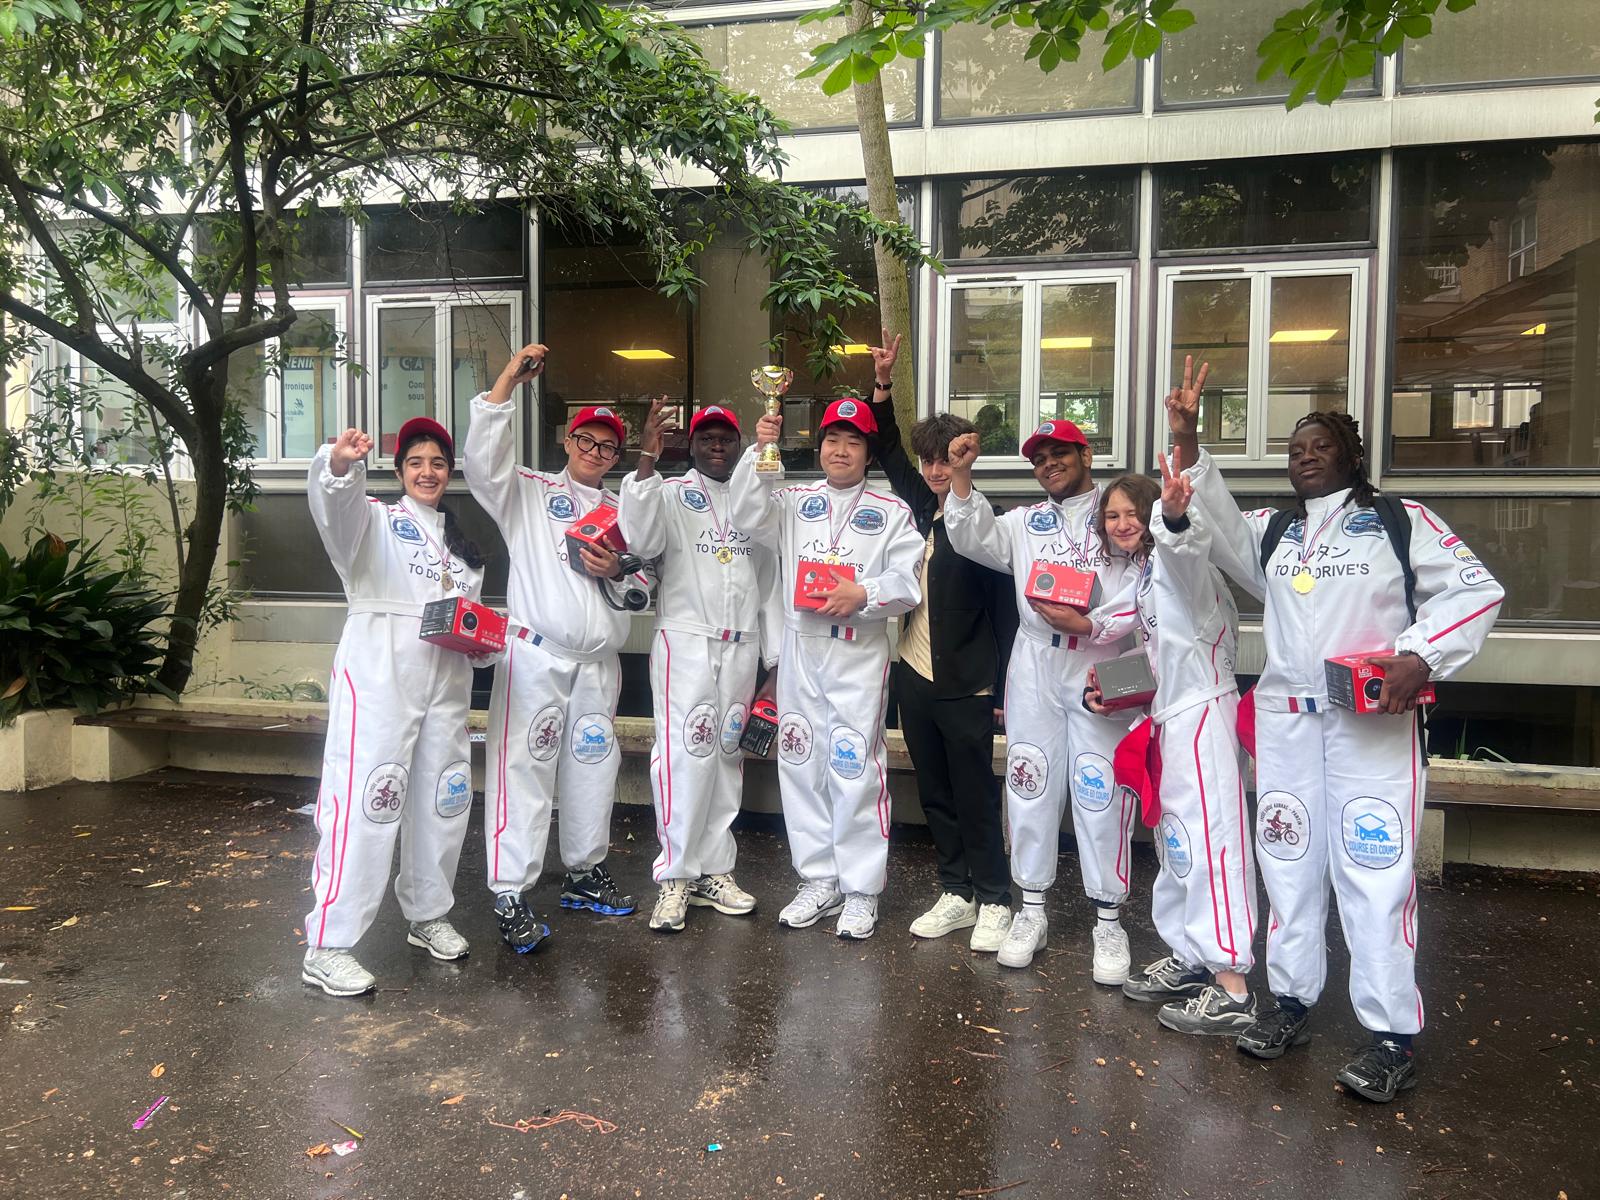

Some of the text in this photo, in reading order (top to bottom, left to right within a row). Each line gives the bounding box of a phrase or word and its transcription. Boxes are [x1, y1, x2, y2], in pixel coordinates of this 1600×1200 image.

[695, 543, 709, 553] TO
[409, 563, 424, 575] TO
[426, 569, 440, 582] DO
[1275, 565, 1289, 576] TO
[1466, 569, 1483, 580] PFA
